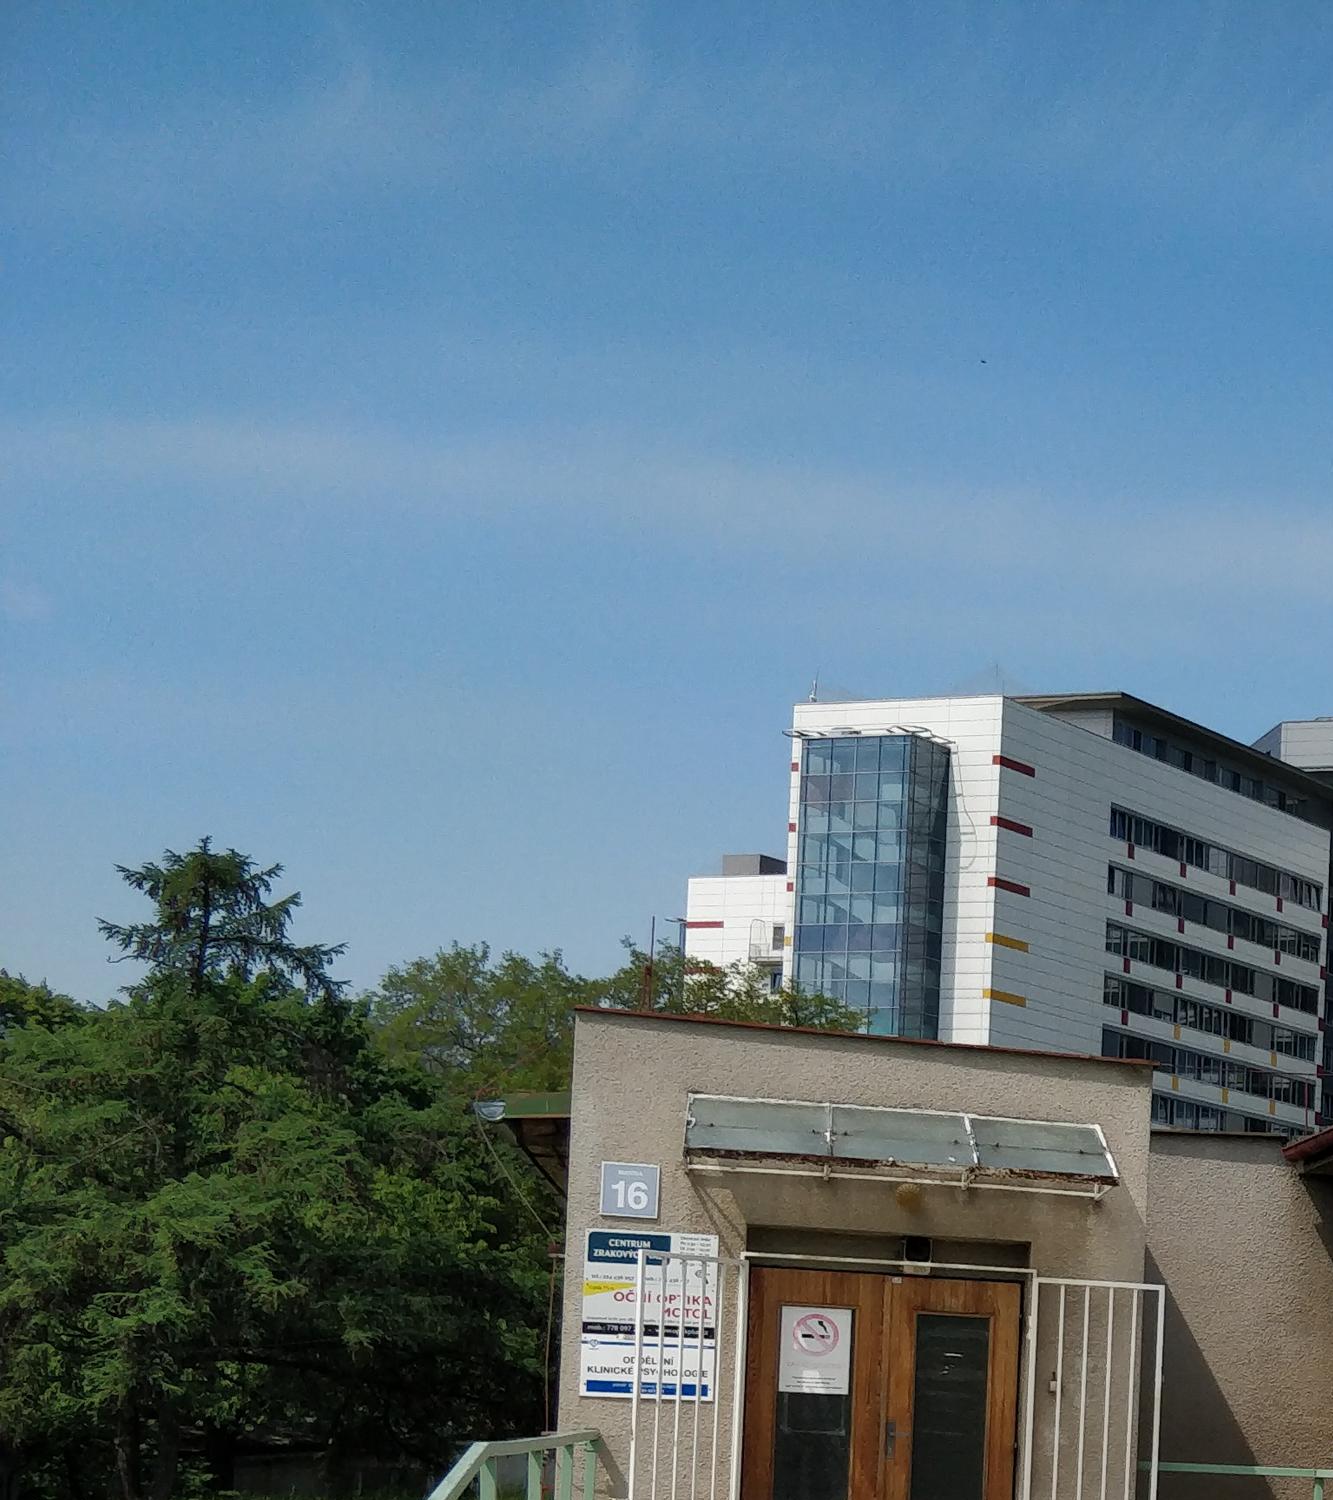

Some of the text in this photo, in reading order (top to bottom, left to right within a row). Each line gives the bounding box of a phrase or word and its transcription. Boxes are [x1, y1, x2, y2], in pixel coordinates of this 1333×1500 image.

[611, 1180, 648, 1210] 16
[608, 1238, 651, 1249] CENTRUM
[587, 1365, 634, 1375] KLINICKÉ
